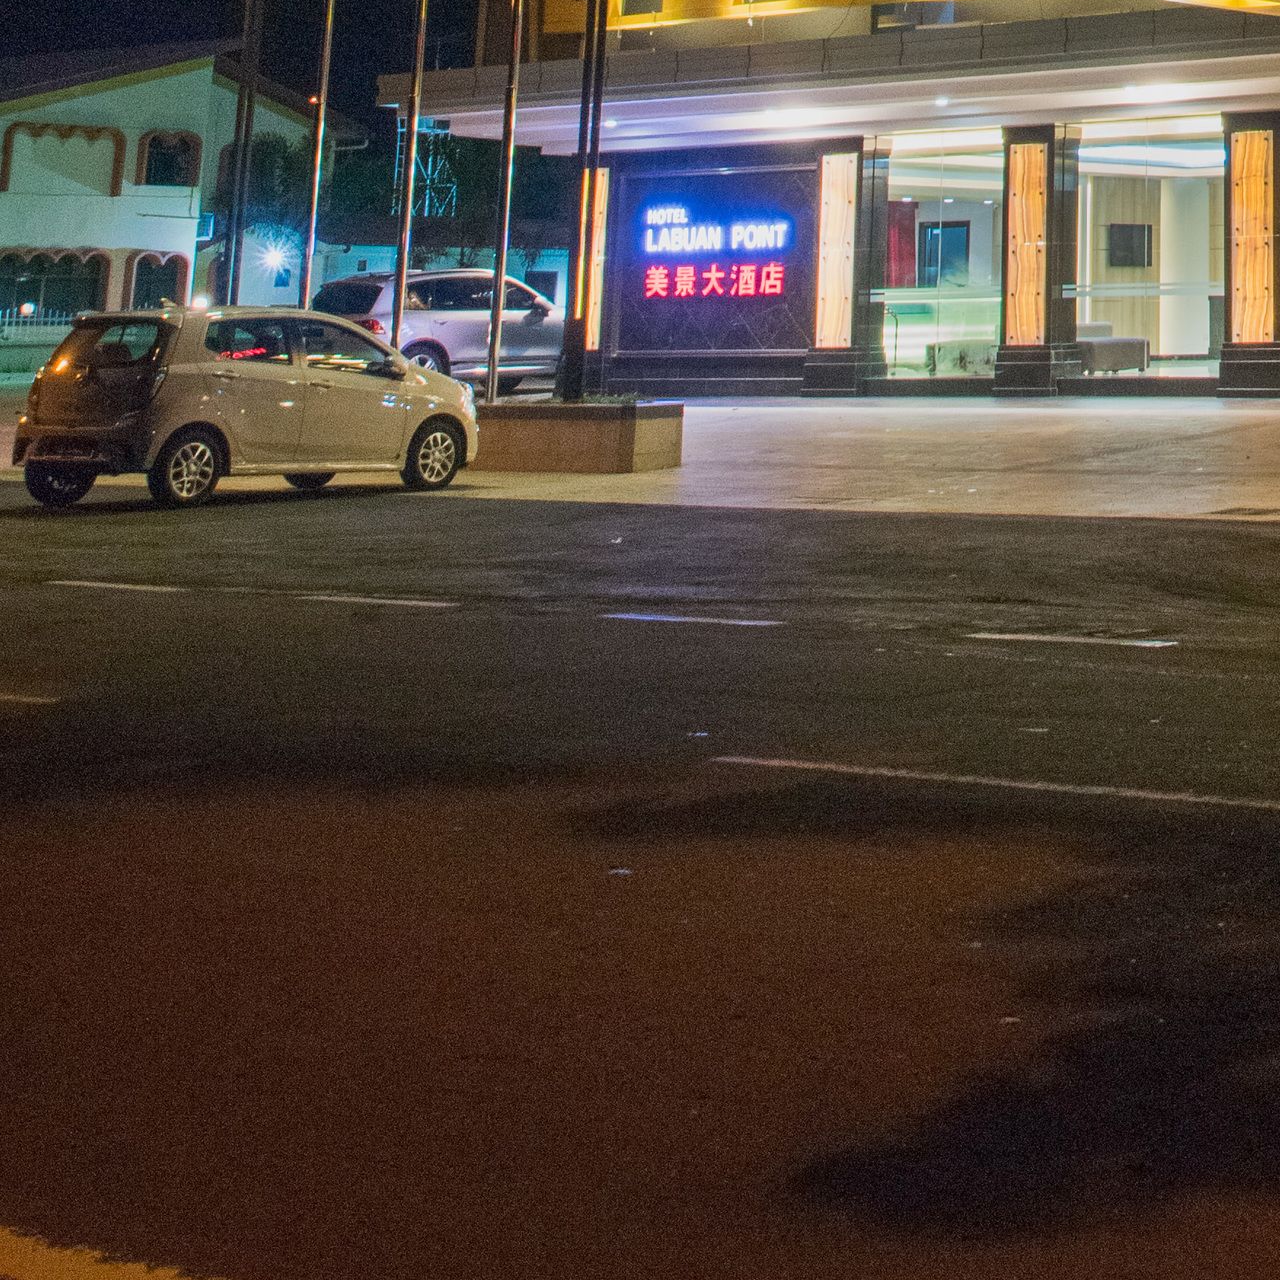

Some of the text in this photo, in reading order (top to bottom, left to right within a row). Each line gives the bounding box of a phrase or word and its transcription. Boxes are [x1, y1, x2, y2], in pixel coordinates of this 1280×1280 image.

[646, 207, 688, 225] HOTEL
[645, 223, 788, 252] LABUAN POINT
[645, 262, 785, 298] 美景大酒店
